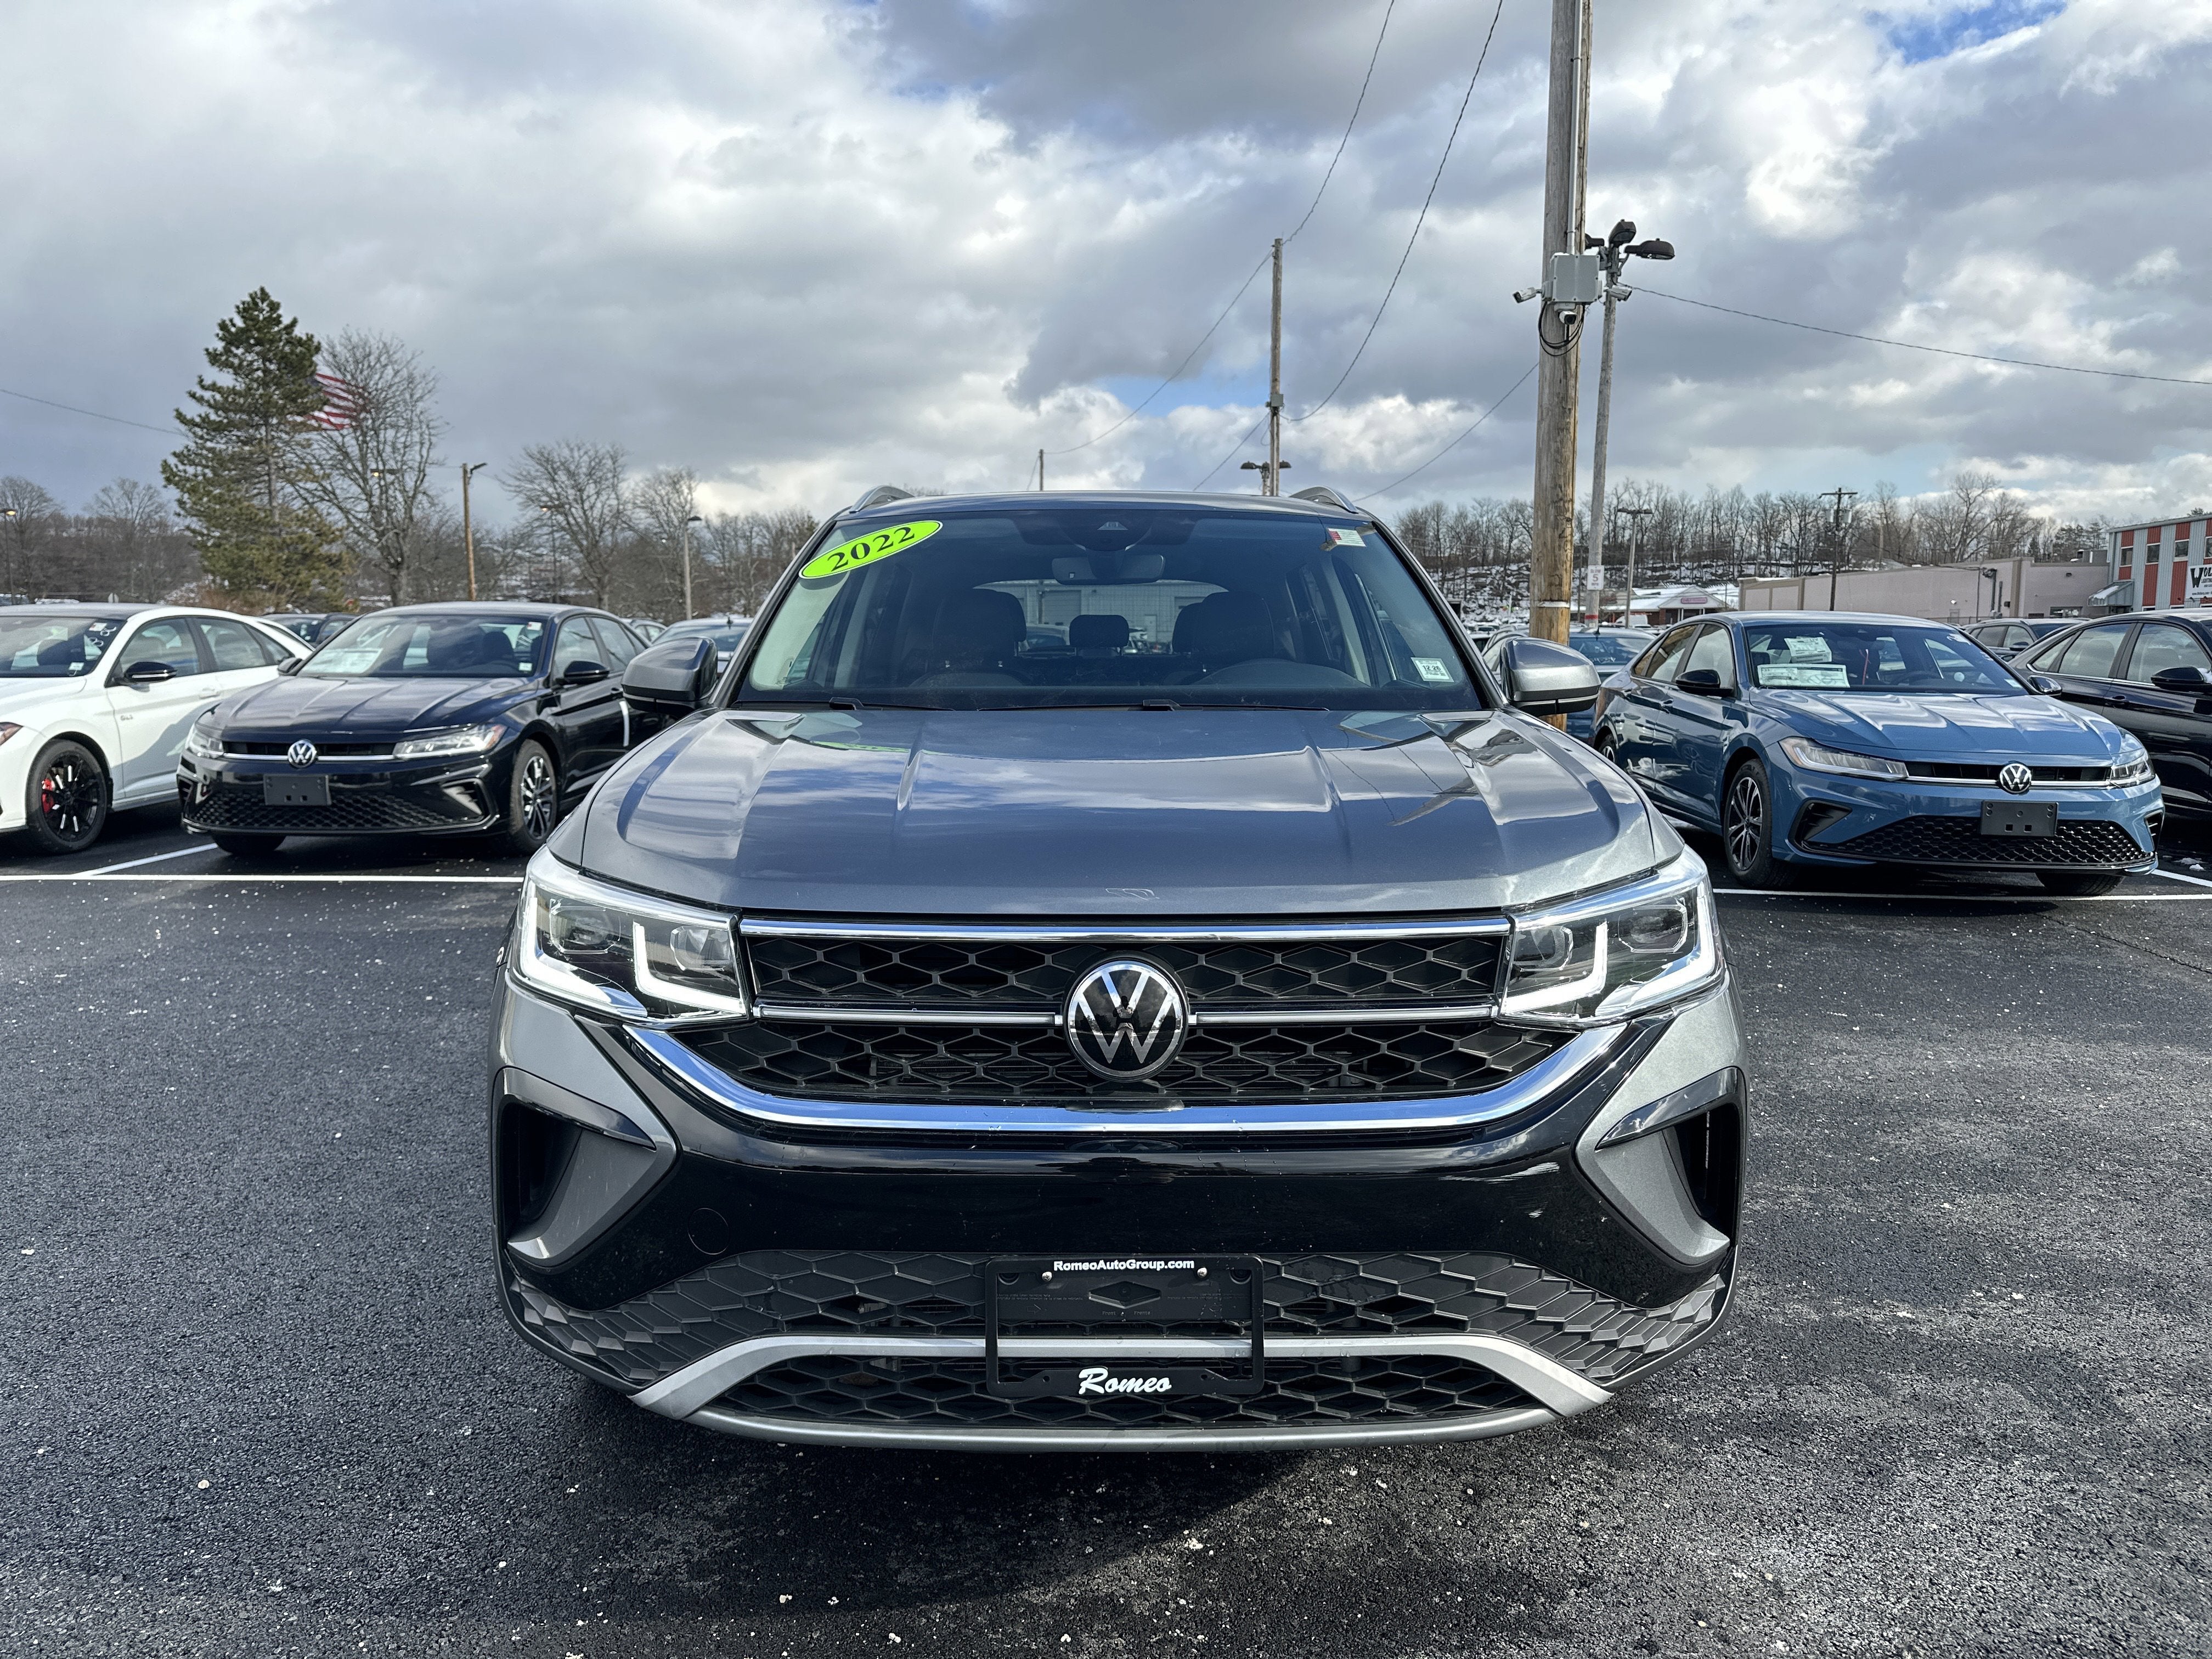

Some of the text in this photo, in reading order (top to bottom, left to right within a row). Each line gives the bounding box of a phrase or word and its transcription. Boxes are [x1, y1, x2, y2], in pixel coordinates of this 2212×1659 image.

[827, 527, 915, 572] 2022
[289, 740, 315, 767] VW
[2001, 764, 2031, 791] VW
[1071, 964, 1179, 1067] VW
[1054, 1260, 1194, 1271] RomeoAutoGroup.com
[1079, 1367, 1172, 1395] Romeo
